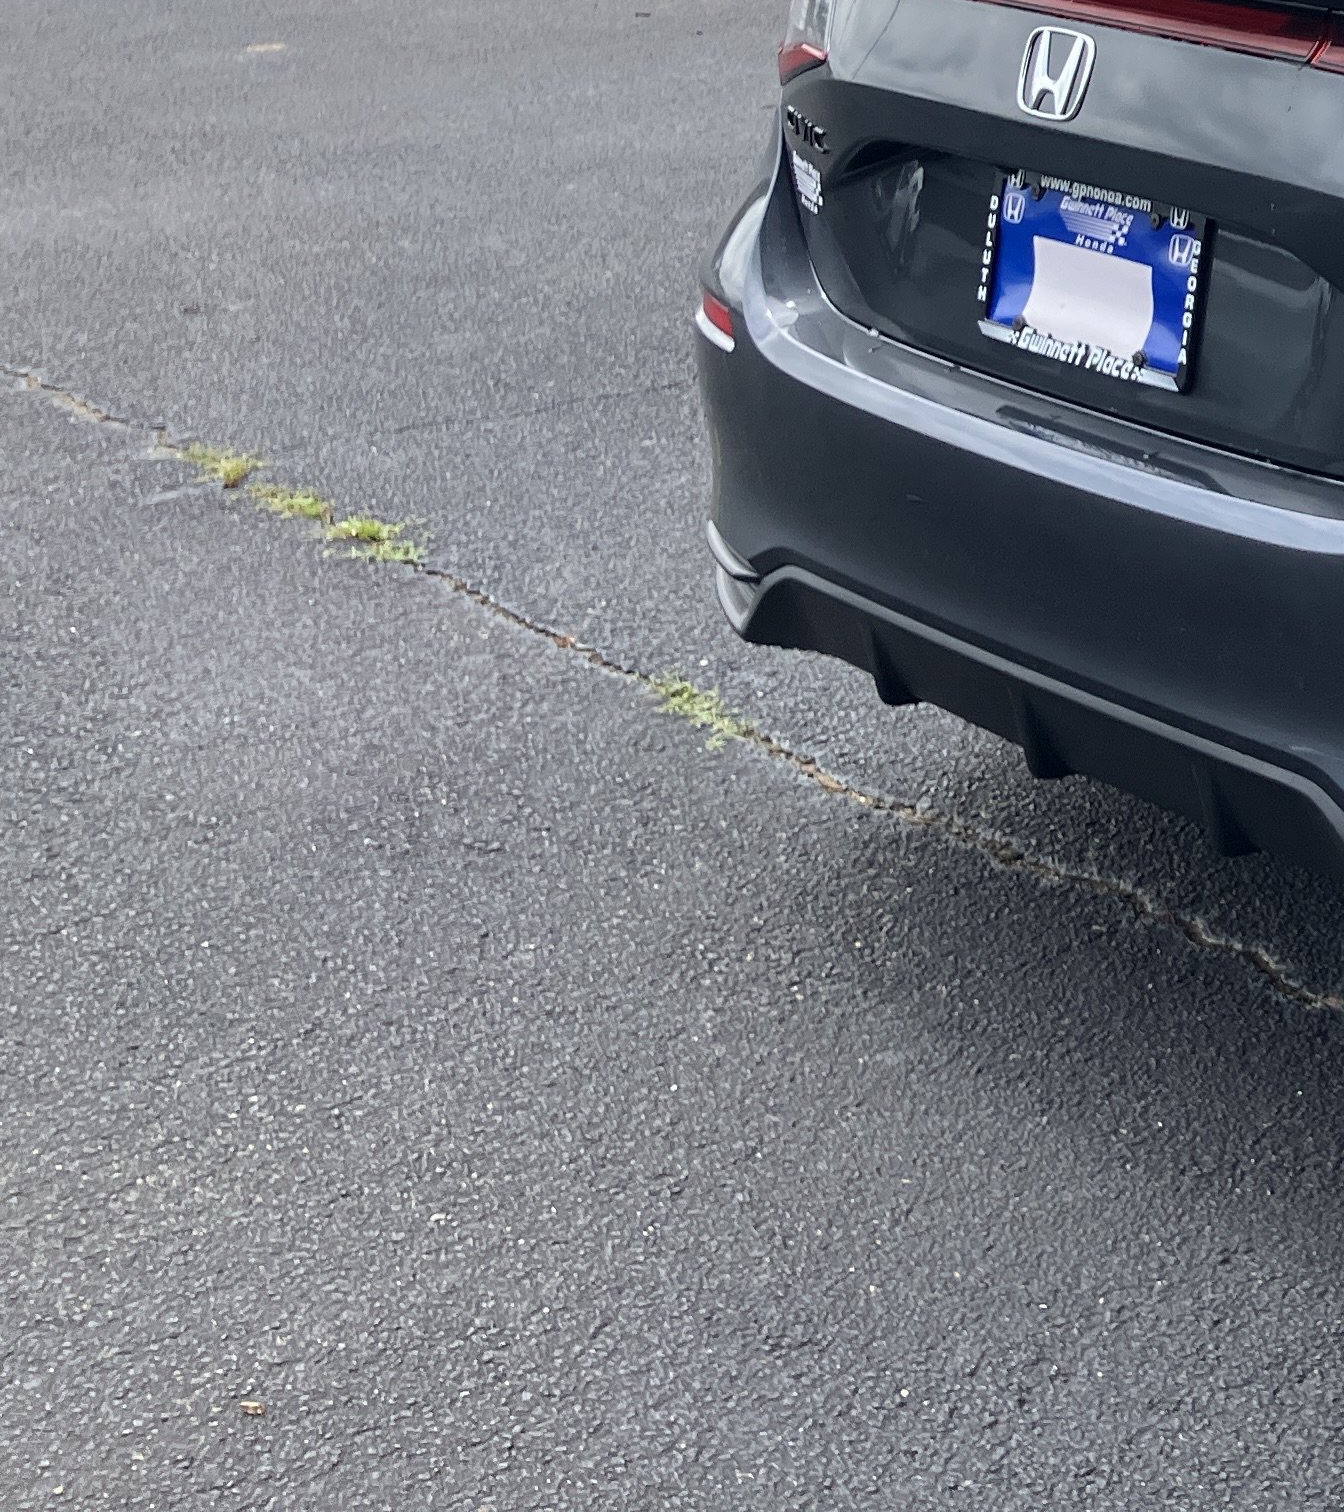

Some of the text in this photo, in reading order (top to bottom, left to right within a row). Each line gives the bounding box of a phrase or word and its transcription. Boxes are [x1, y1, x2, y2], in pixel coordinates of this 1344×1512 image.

[977, 195, 999, 303] DULUTH
[1075, 234, 1114, 254] Honda
[1177, 239, 1202, 365] GEORGIA
[1018, 325, 1136, 381] Gwinnett Place
